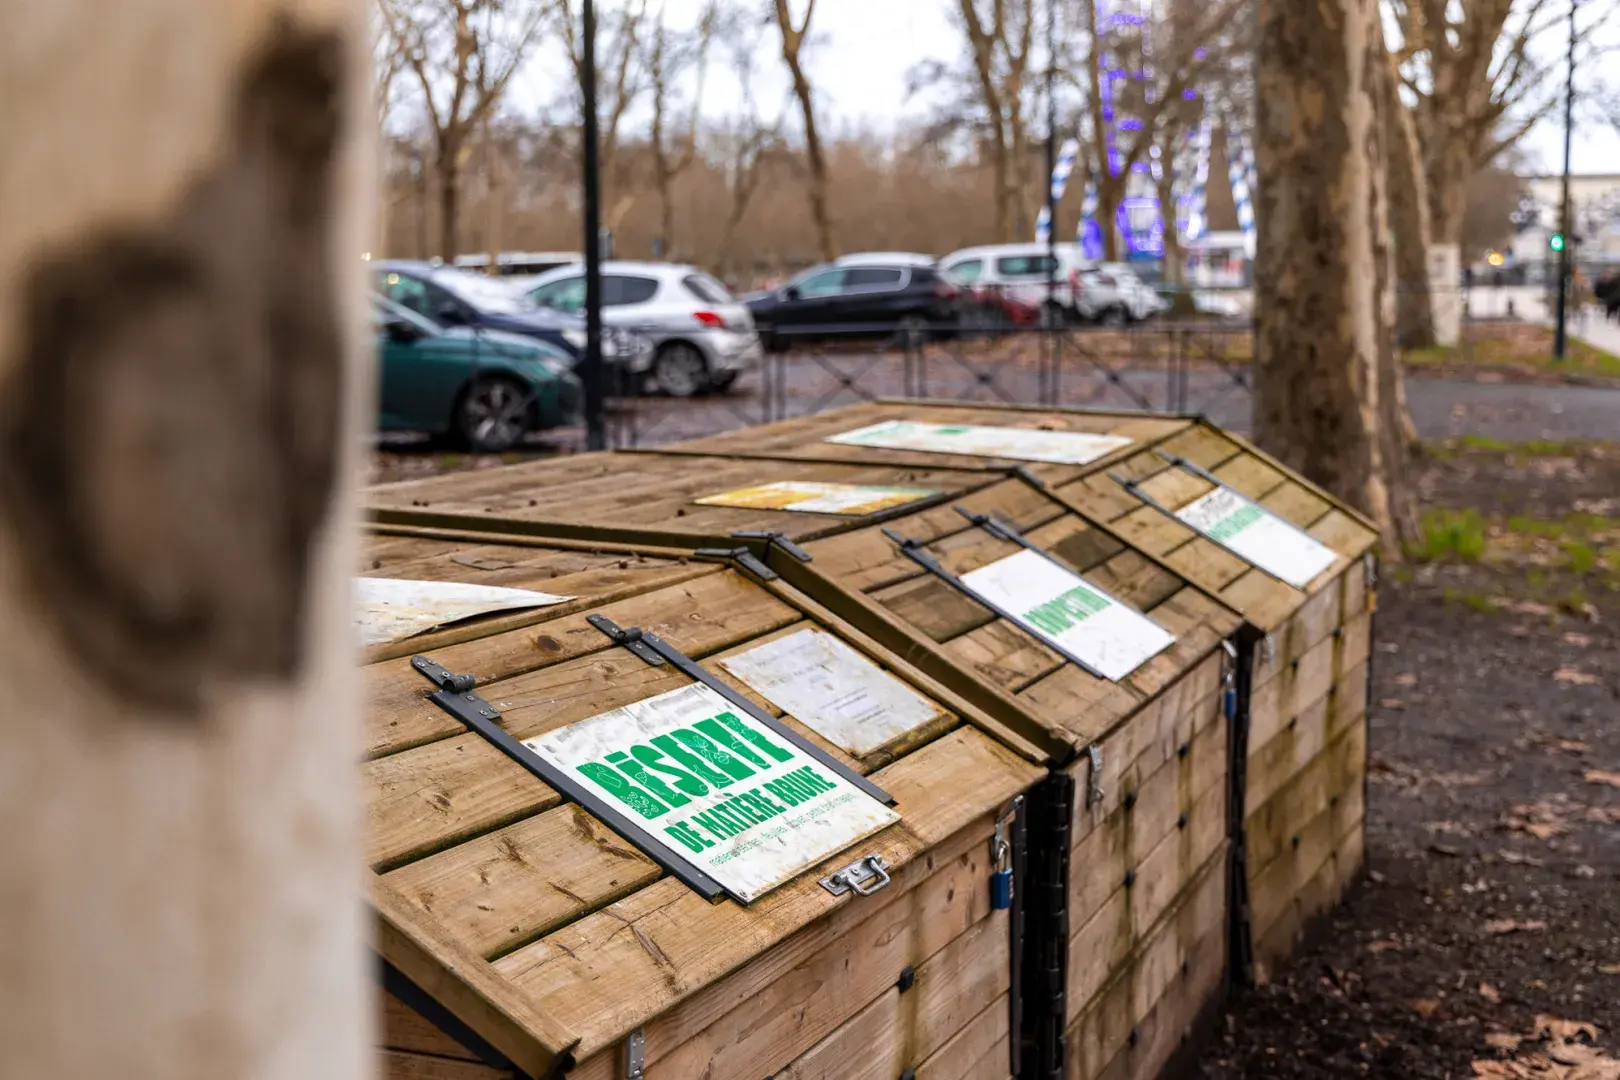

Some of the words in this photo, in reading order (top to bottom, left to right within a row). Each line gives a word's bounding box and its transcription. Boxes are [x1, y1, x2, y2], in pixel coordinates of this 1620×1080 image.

[663, 823, 716, 854] DE
[690, 788, 787, 841] MATIÈRE
[761, 764, 838, 808] BRUNE
